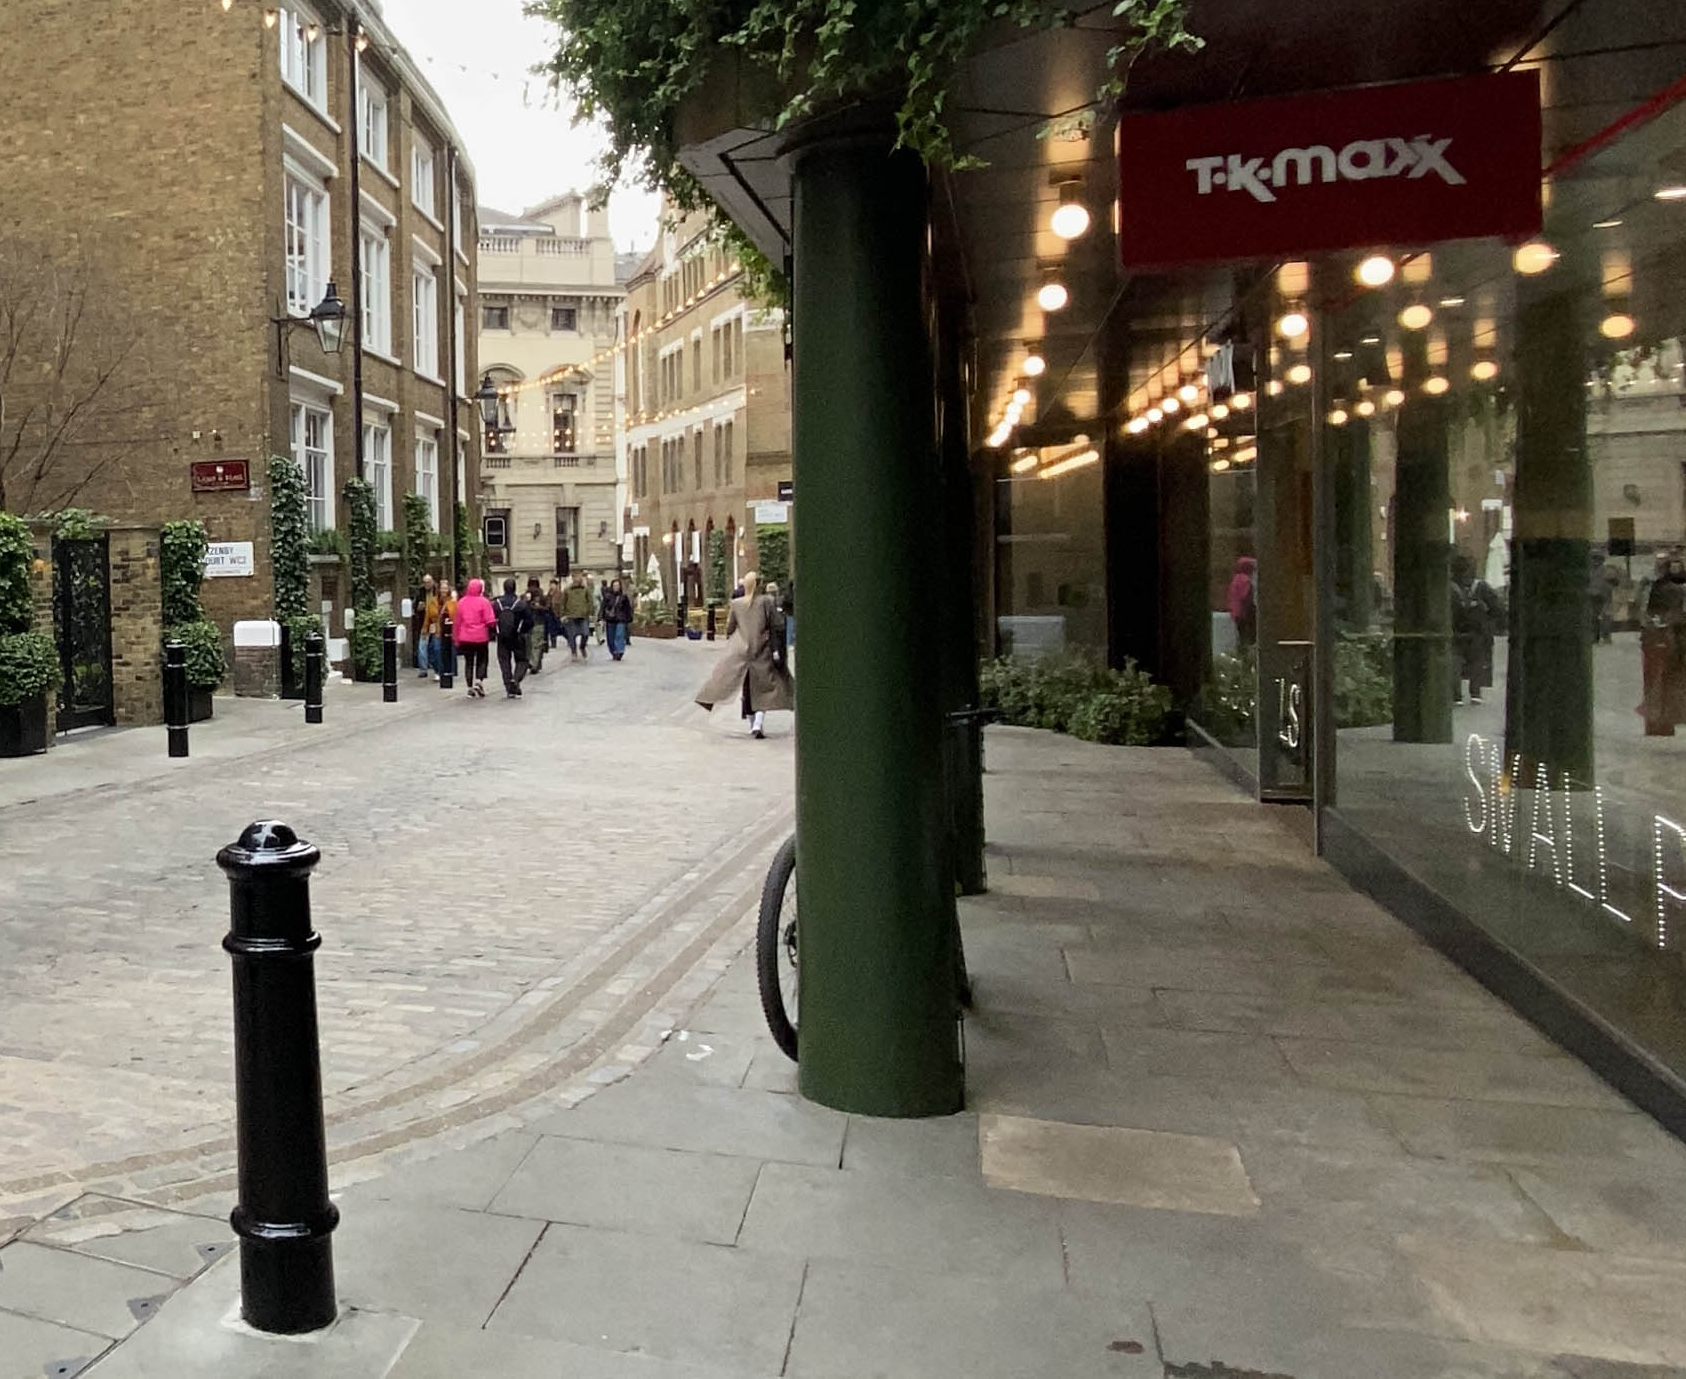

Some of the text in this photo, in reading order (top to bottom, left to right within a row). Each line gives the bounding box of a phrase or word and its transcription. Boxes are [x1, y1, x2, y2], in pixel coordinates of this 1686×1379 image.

[203, 547, 234, 555] ZENBY
[202, 556, 225, 565] OURT
[1464, 733, 1632, 922] SMALL
